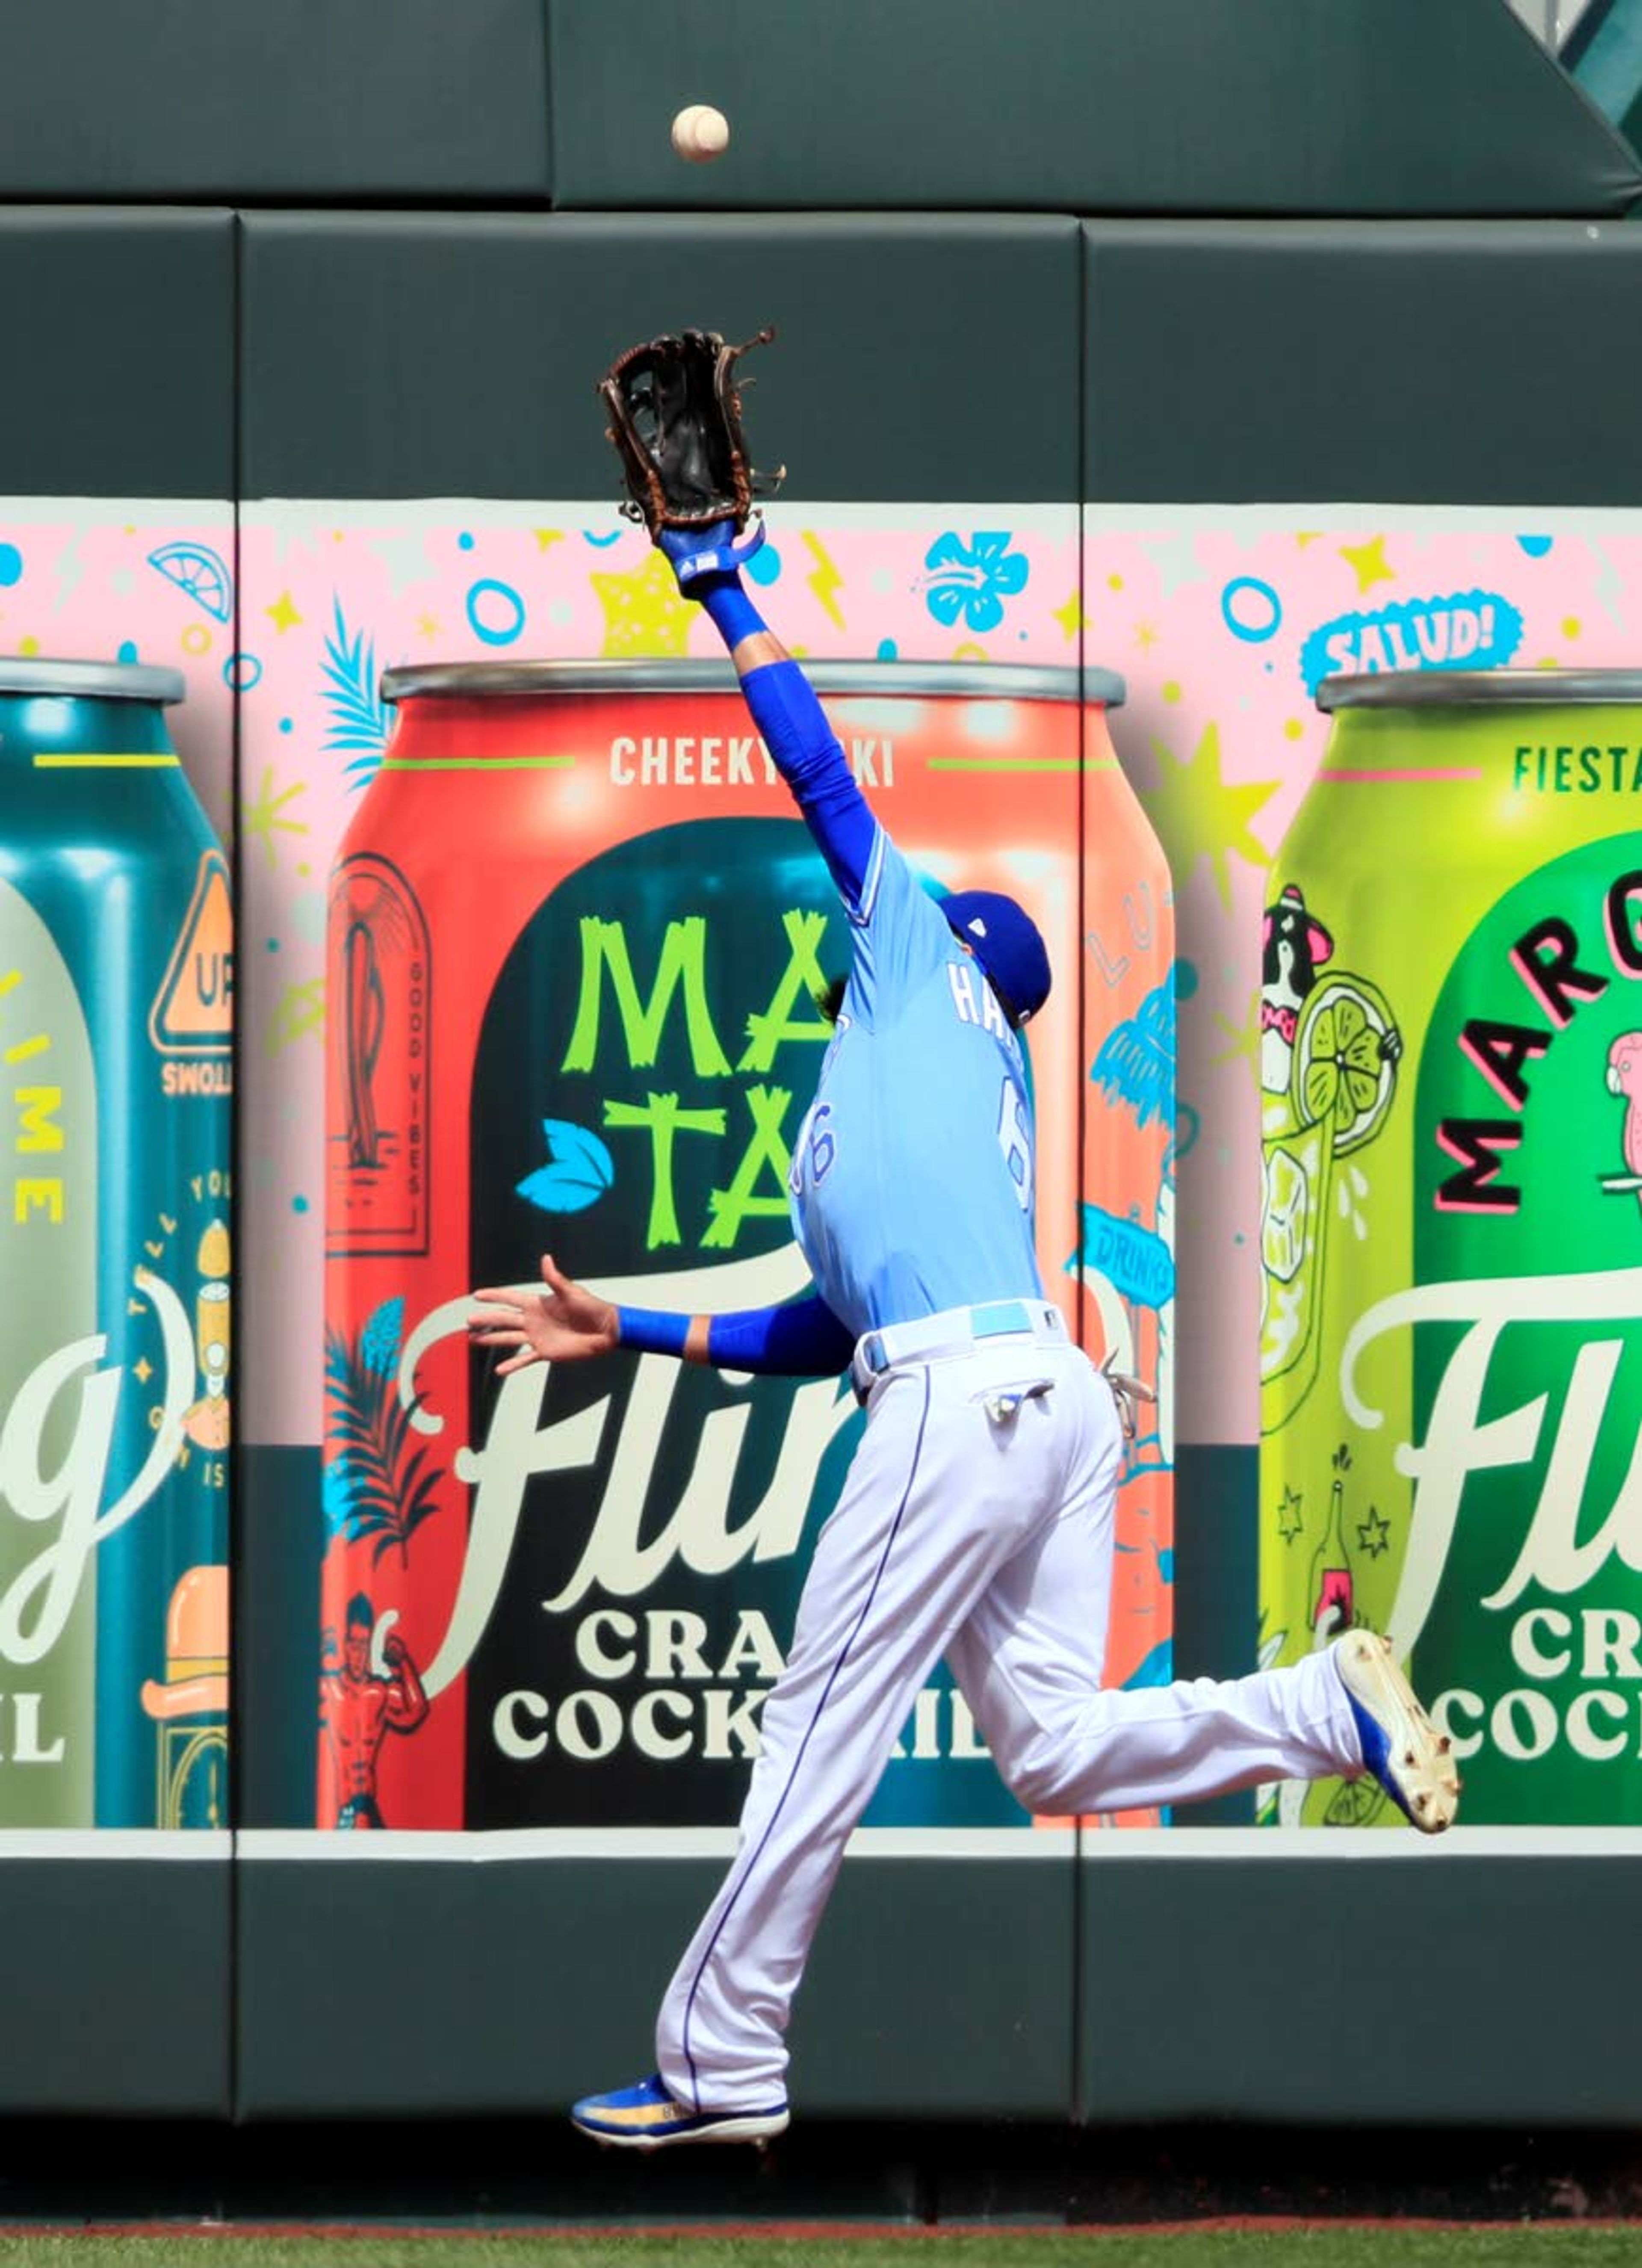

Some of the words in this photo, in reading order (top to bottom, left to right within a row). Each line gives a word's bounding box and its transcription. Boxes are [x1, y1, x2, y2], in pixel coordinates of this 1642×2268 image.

[1326, 604, 1495, 676] SALUD!
[610, 736, 777, 786] CHEEKY
[1086, 880, 1175, 988] LU
[560, 908, 836, 1077] MA
[408, 1073, 421, 1195] VIBES
[603, 1084, 791, 1250] TA
[371, 1240, 868, 1700] Flin
[1315, 1266, 1642, 1663] Fl
[575, 1609, 788, 1679] CRA
[1430, 1688, 1642, 1760] COC
